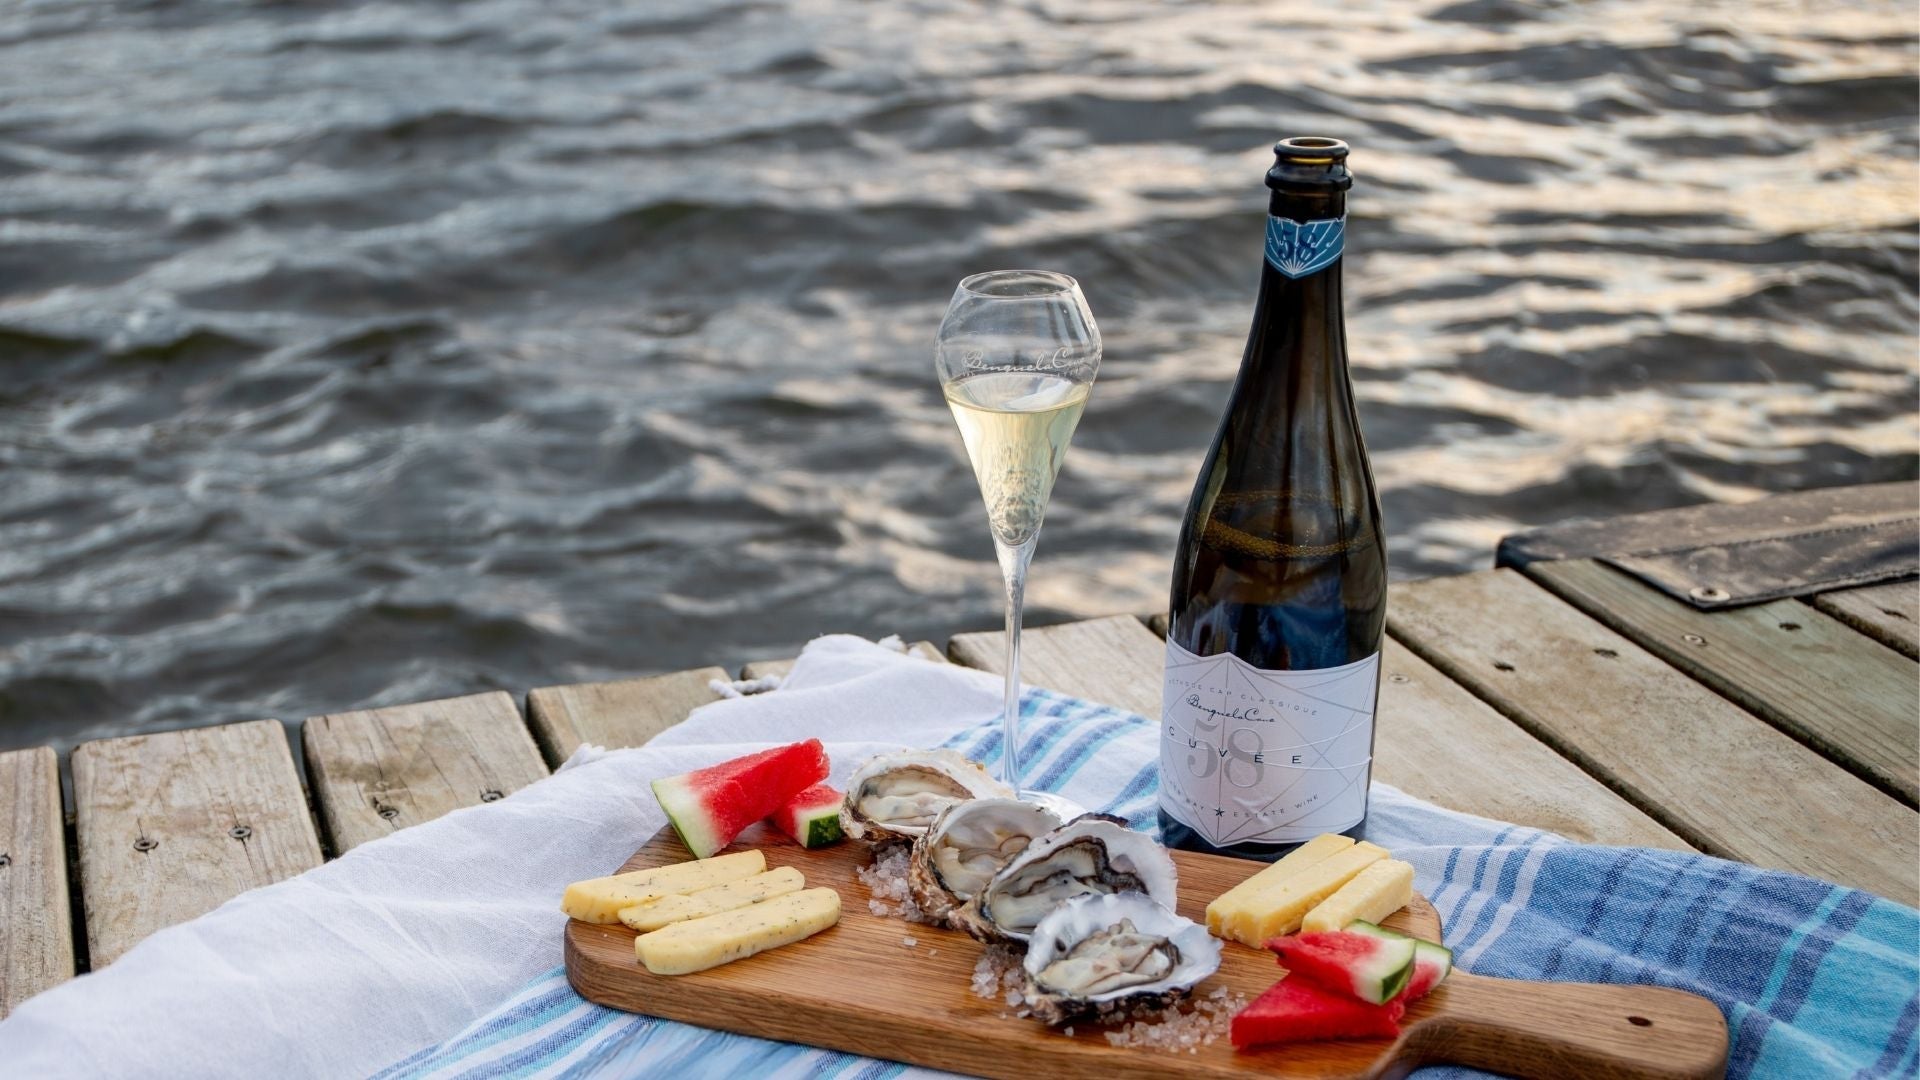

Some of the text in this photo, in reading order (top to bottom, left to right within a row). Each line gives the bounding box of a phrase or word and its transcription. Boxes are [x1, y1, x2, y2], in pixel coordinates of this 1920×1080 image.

[1279, 230, 1317, 261] 58
[1168, 726, 1302, 764] CUVÉE
[1186, 718, 1265, 789] 58
